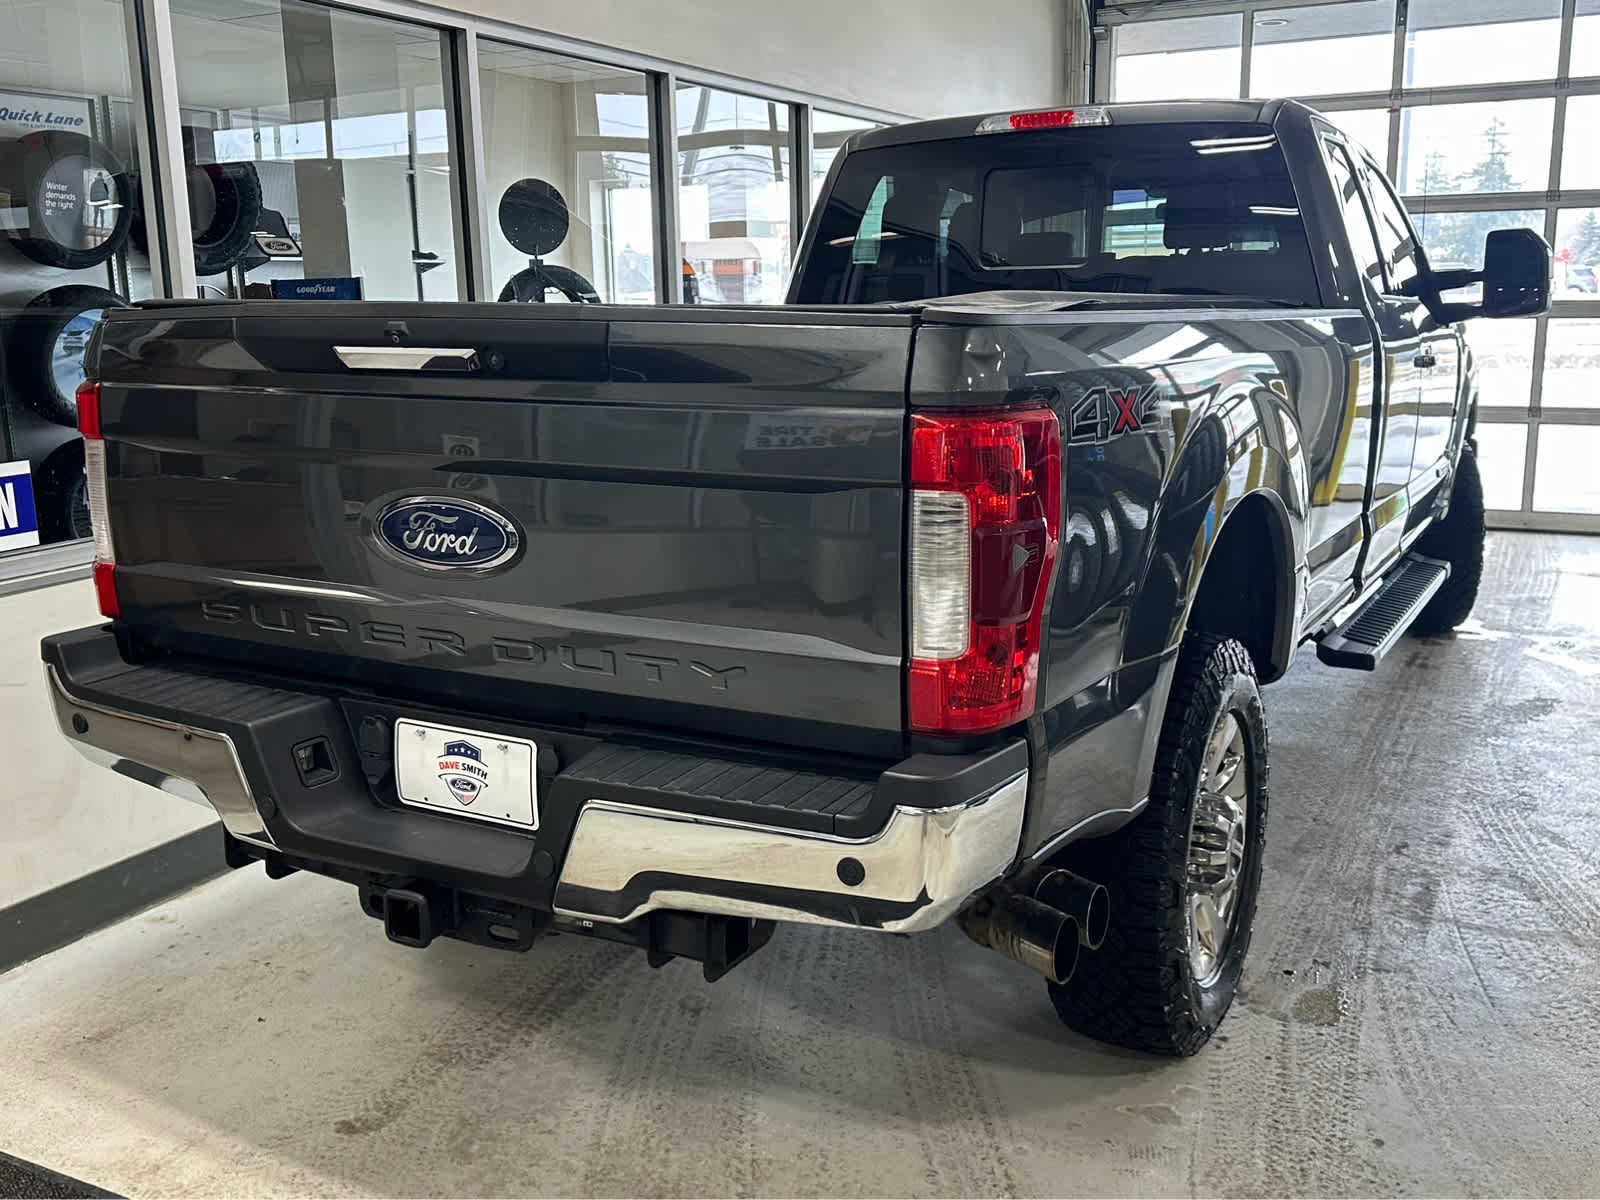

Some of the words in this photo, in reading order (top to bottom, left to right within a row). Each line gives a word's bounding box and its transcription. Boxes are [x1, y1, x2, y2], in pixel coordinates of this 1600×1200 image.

[0, 107, 43, 123] Quick
[45, 112, 84, 127] Lane
[47, 182, 68, 191] Winter
[45, 190, 76, 201] demands
[45, 199, 57, 208] the
[296, 283, 336, 294] GOODYEAR
[403, 511, 479, 556] Ford
[202, 600, 466, 657] SUPER
[493, 635, 747, 691] DUTY
[438, 761, 460, 770] DAVE
[461, 763, 488, 780] SMITH
